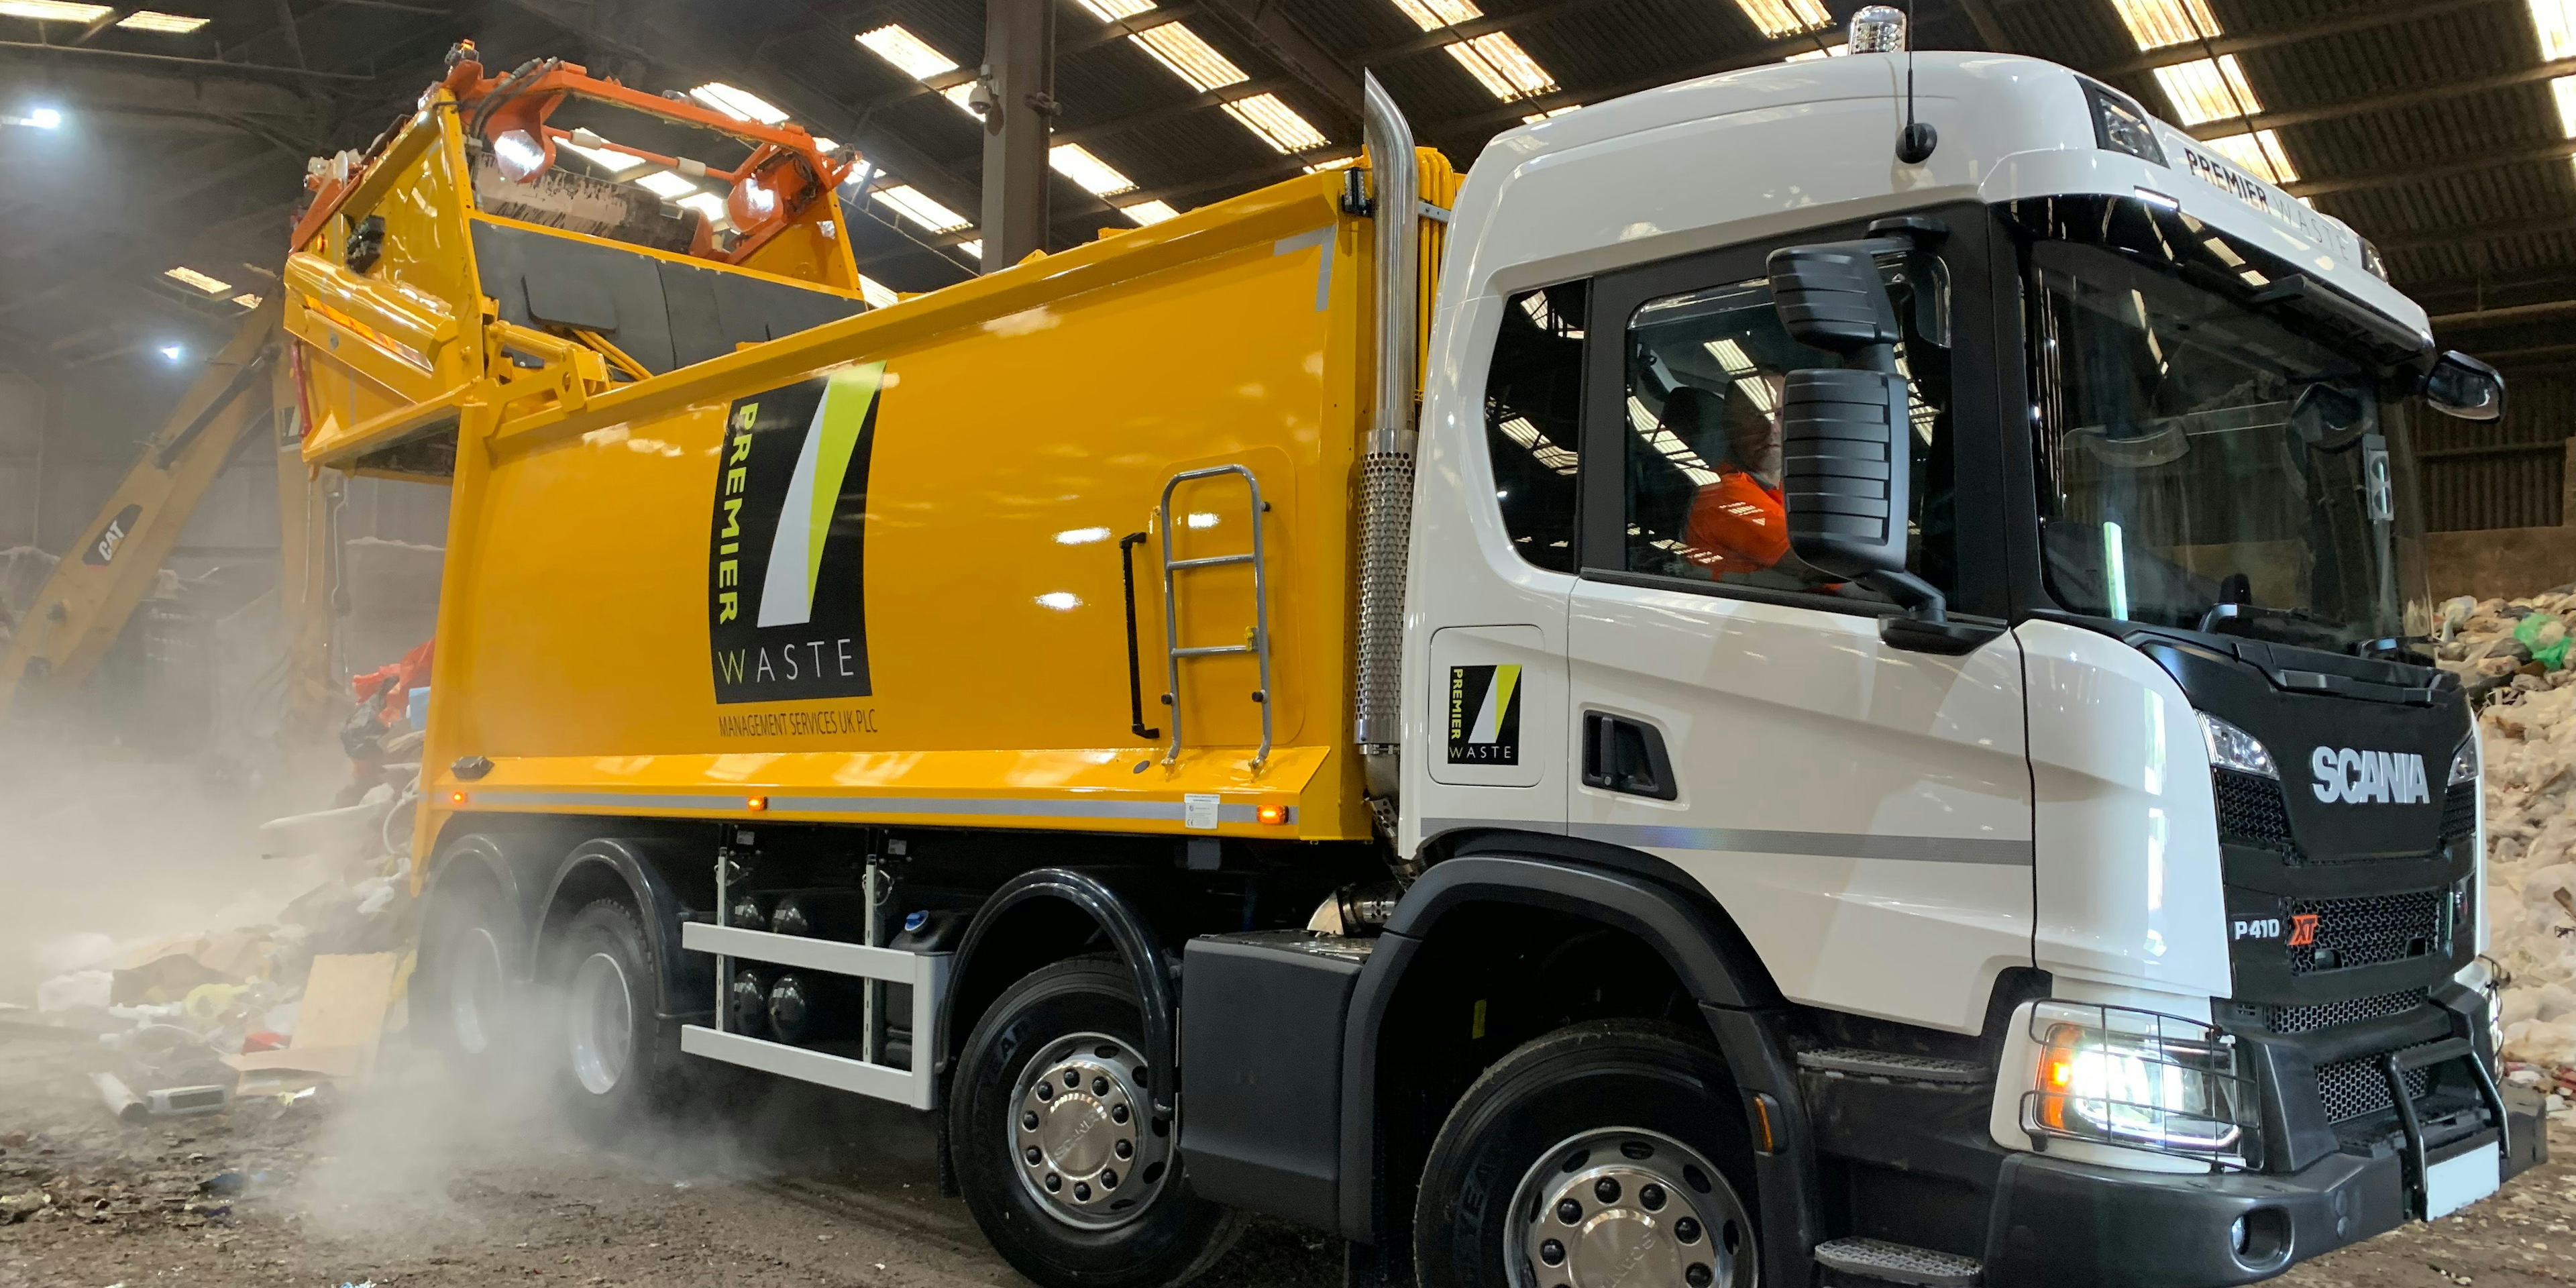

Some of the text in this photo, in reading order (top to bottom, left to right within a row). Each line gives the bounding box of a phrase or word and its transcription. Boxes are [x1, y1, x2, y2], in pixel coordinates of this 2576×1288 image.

[2184, 148, 2349, 262] PREMIER WASTE
[718, 402, 759, 625] PREMIER
[99, 520, 125, 561] CAT
[718, 639, 854, 684] WASTE
[718, 708, 878, 737] MANAGEMENT SERVICES UK PLC
[1451, 669, 1463, 739] PREMIER
[1449, 746, 1511, 759] WASTE
[2312, 746, 2430, 804] SCANIA
[2234, 919, 2280, 940] P410
[2289, 914, 2318, 946] XT
